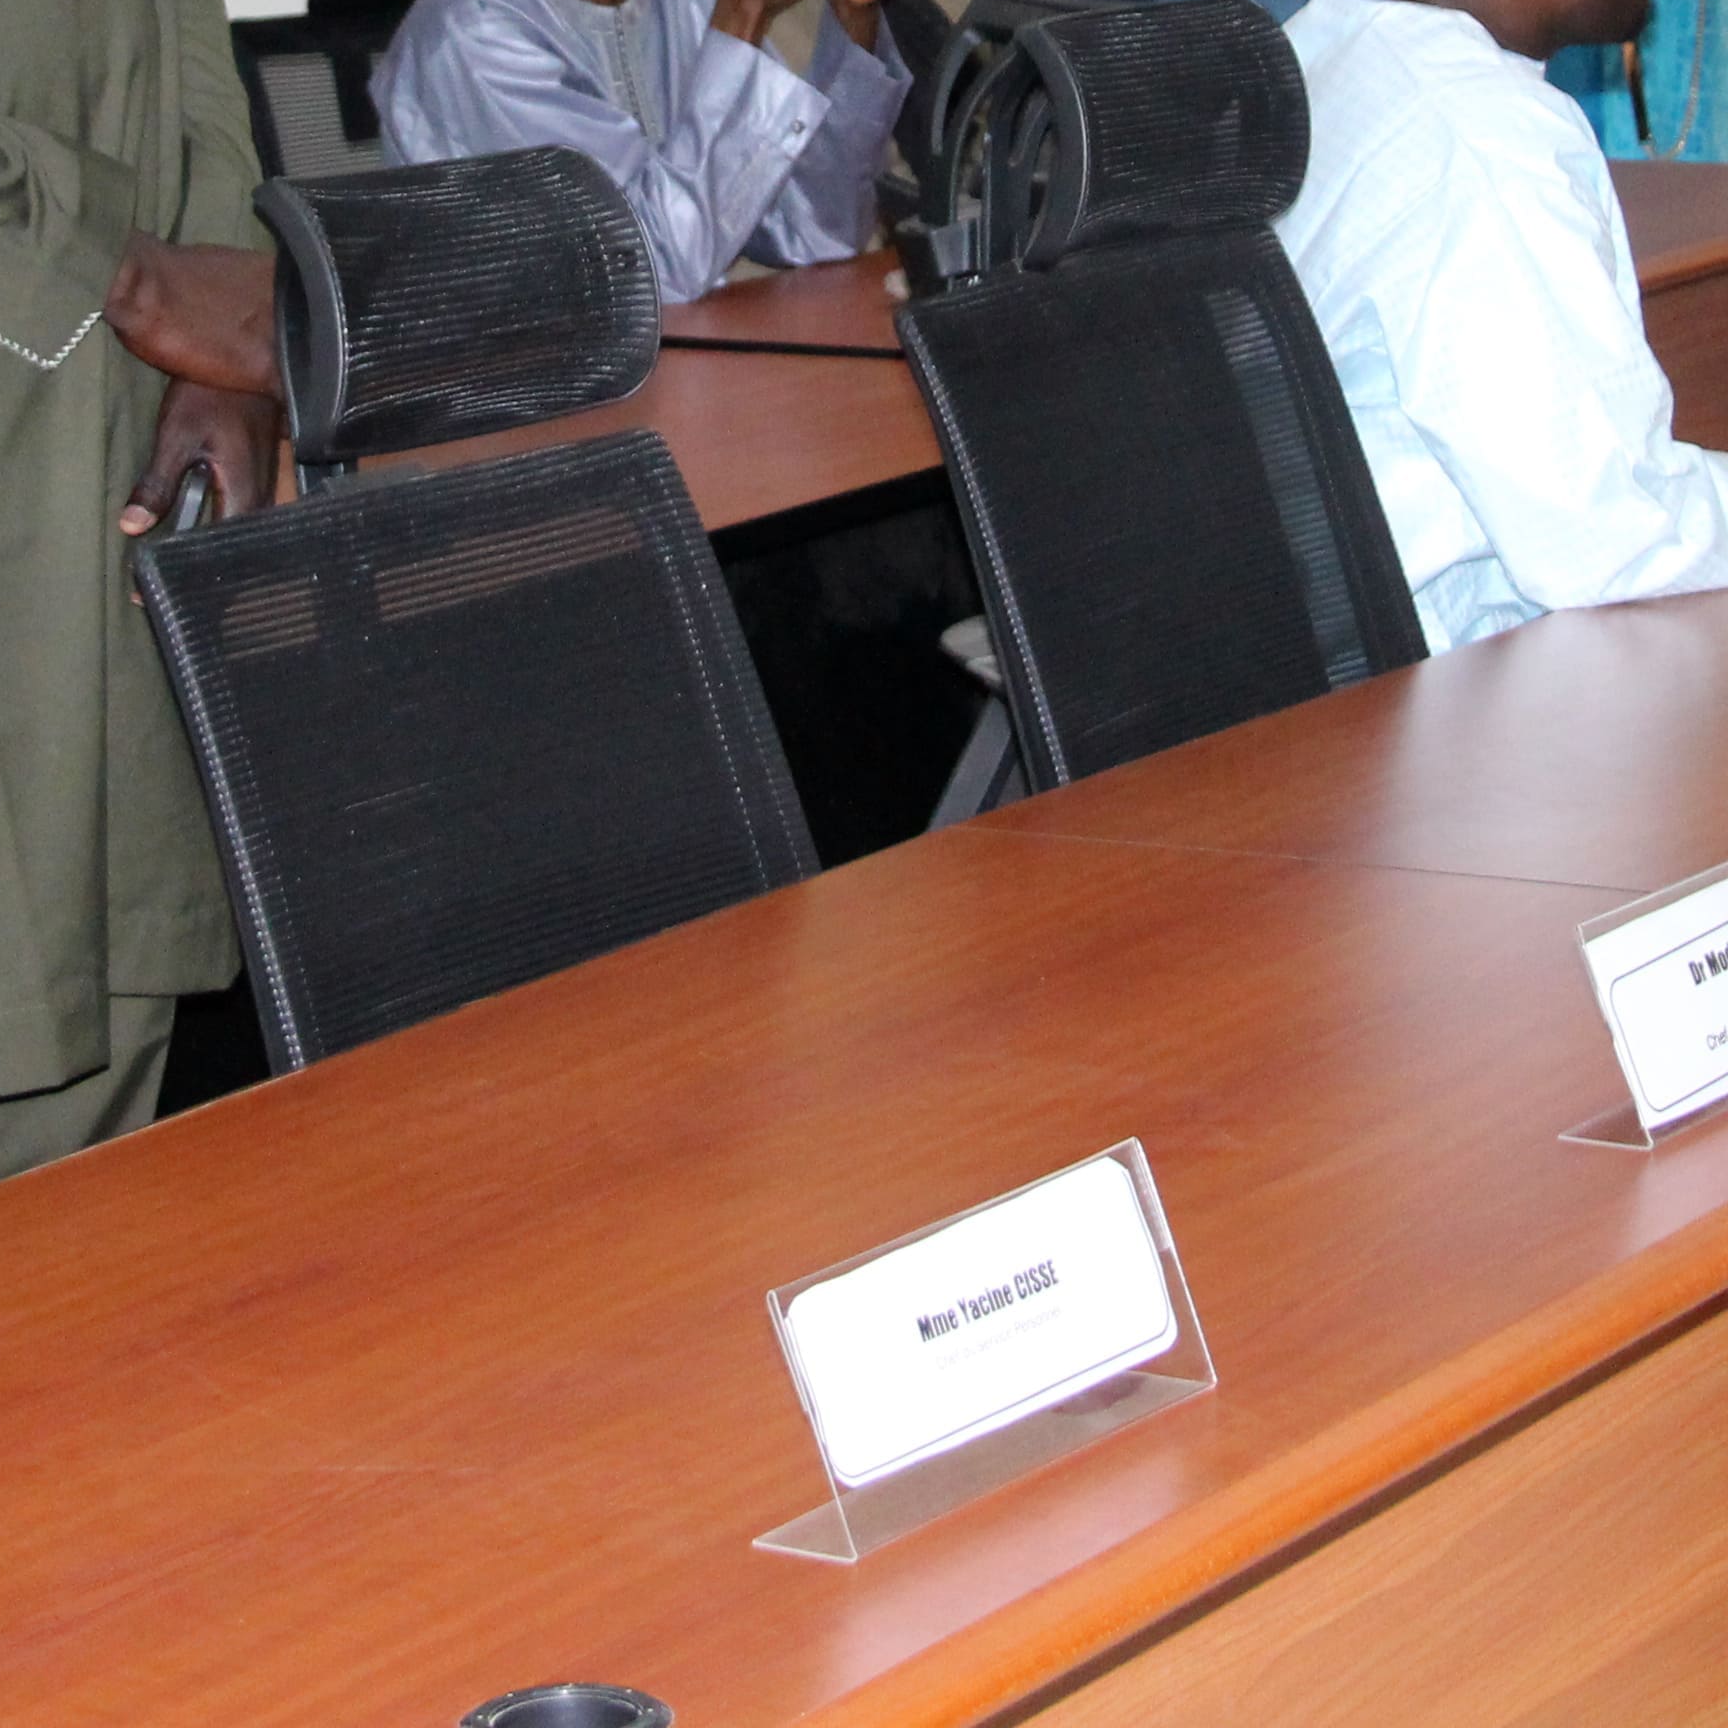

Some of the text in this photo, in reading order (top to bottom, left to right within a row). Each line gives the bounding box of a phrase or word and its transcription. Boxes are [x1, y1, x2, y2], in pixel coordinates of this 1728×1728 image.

[1689, 959, 1707, 985] Dr
[1707, 1026, 1728, 1050] Chef
[916, 1259, 1059, 1342] Mme Yacine CISSE
